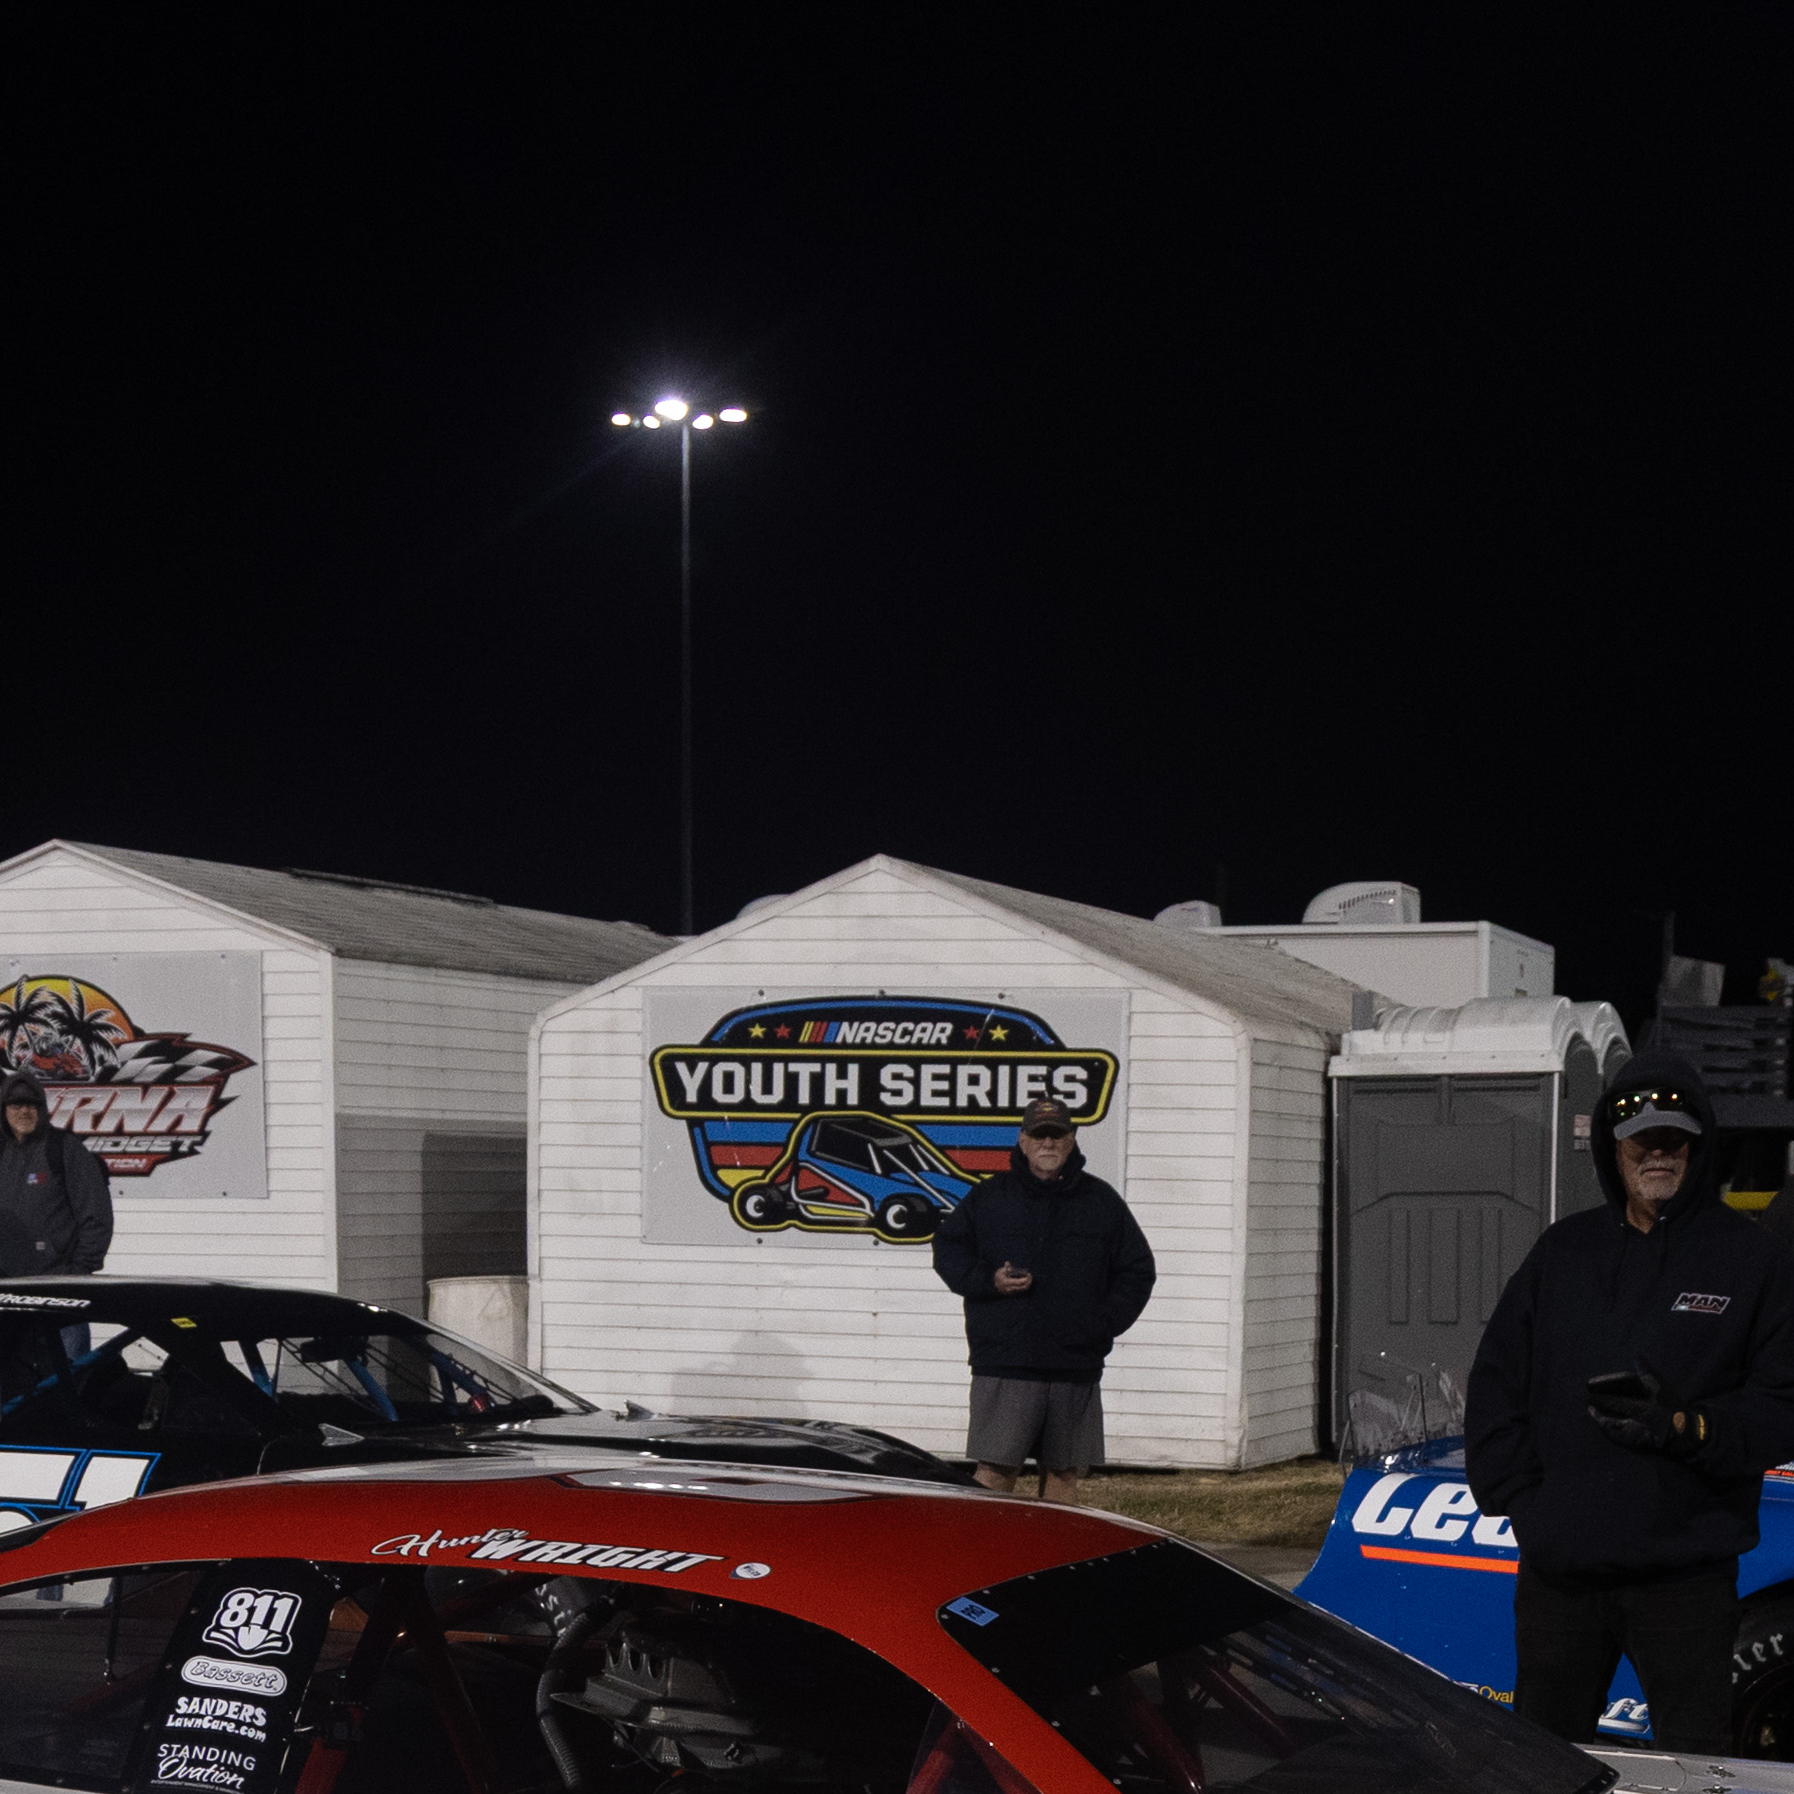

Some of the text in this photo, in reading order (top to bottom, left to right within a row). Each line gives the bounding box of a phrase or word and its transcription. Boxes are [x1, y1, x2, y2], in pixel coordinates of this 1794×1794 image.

[835, 1021, 954, 1045] NASCAR
[674, 1061, 1088, 1109] YOUTH SERIES
[469, 1537, 726, 1574] WRIGHT
[220, 1591, 295, 1633] 811
[189, 1659, 281, 1691] Bassett
[175, 1696, 267, 1727] SANDERS
[157, 1743, 257, 1772] STANDING
[158, 1756, 245, 1790] Ovation
